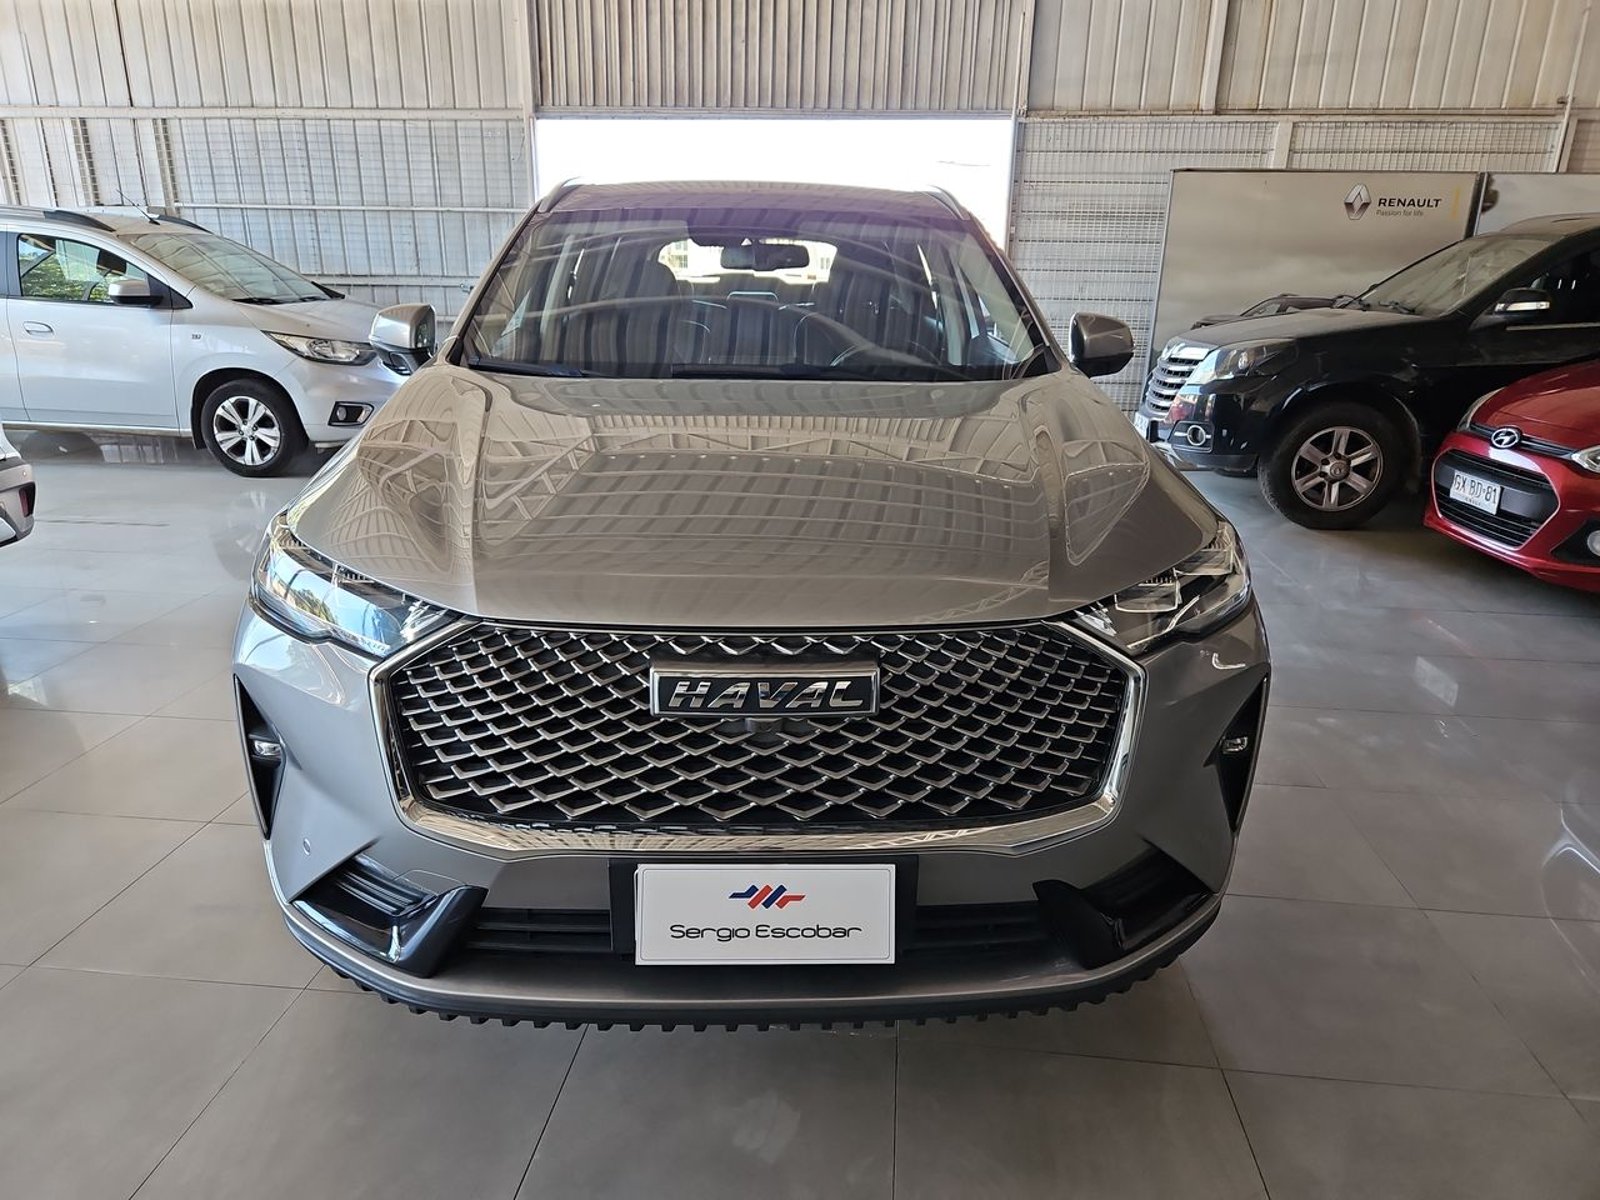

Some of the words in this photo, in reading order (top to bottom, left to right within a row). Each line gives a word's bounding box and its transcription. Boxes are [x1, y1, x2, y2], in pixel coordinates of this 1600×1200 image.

[1378, 198, 1442, 208] RENAULT
[668, 681, 863, 708] HAVAL
[669, 924, 750, 942] Sergio
[755, 924, 862, 939] Escobar
